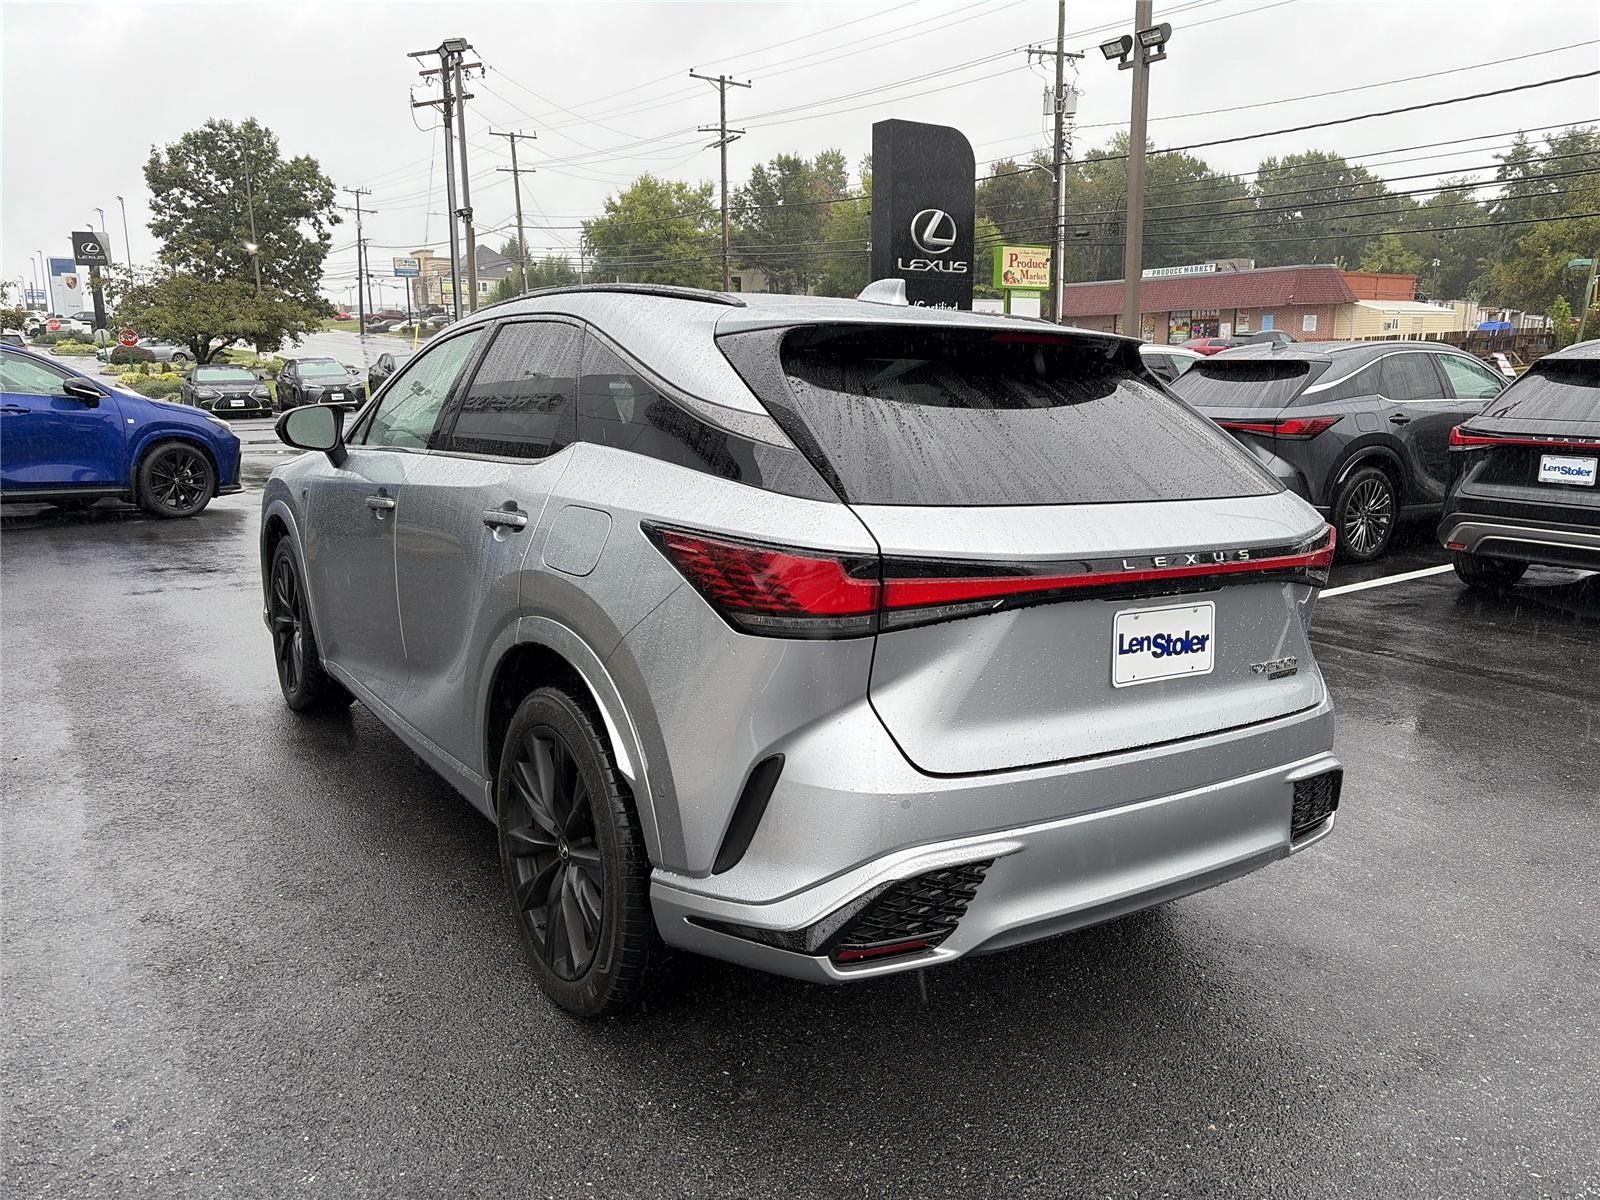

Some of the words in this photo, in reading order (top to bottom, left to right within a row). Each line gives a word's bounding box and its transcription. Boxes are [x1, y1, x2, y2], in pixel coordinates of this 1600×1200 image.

[897, 257, 968, 273] LEXUS
[1008, 252, 1048, 268] Produce
[1020, 269, 1047, 280] Market
[1152, 267, 1183, 276] PRODUCE
[1183, 264, 1214, 273] MARKET
[120, 334, 137, 342] STOP
[1122, 549, 1250, 570] LEXUS
